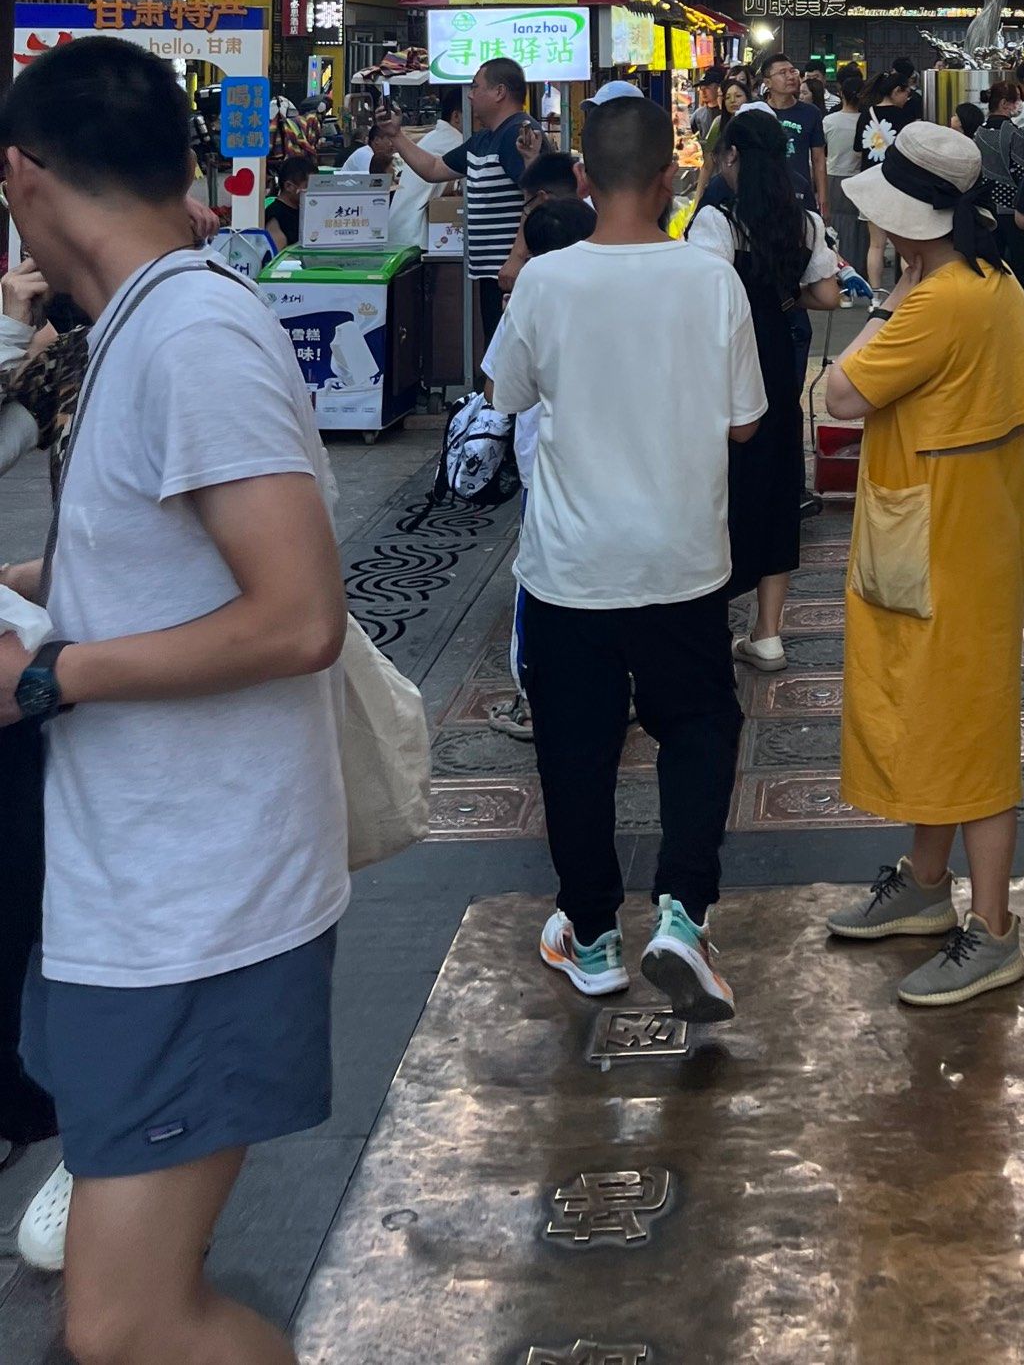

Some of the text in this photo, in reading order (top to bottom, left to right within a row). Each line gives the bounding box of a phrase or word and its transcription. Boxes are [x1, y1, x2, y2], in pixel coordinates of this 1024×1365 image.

[513, 21, 567, 34] lanzhou
[150, 37, 242, 55] hello, 甘肃
[447, 36, 575, 66] 寻味驿站
